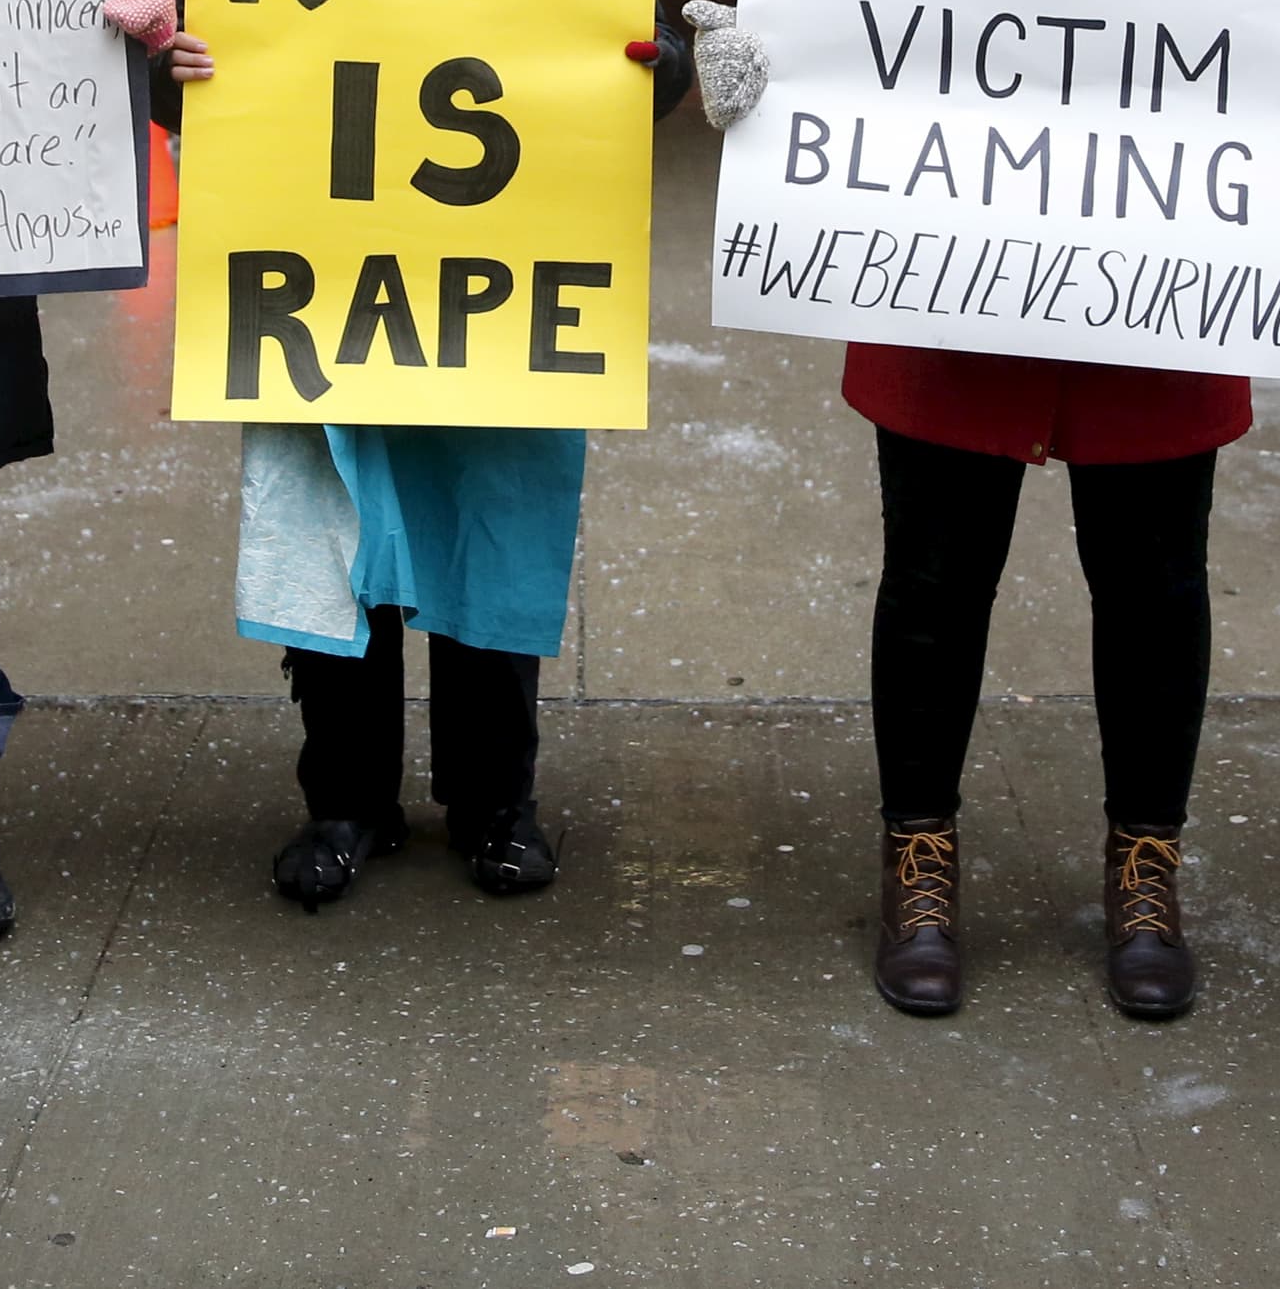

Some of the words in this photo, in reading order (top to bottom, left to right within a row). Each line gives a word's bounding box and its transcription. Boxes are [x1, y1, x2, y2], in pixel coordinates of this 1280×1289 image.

[49, 77, 98, 110] an
[859, 0, 1230, 114] VICTIM
[329, 57, 521, 207] IS
[784, 111, 1253, 226] BLAMING
[225, 250, 613, 401] RAPE
